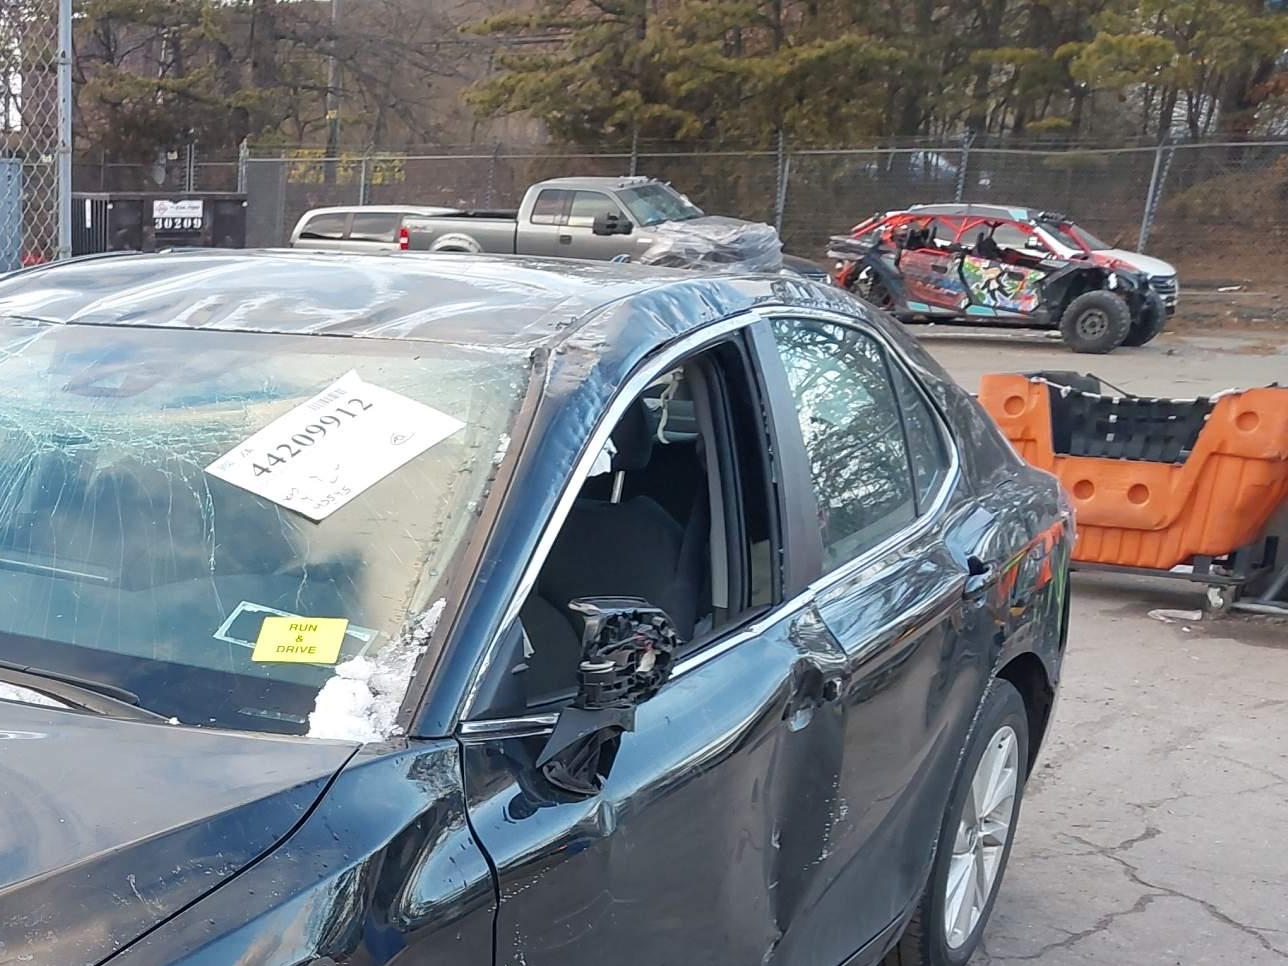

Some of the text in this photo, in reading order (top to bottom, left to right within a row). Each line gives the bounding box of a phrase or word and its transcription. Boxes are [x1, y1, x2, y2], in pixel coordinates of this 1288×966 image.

[155, 218, 202, 229] 30209
[252, 398, 373, 477] 44209912
[289, 623, 318, 632] RUN
[295, 634, 304, 643] &
[276, 645, 317, 654] DRIVE
